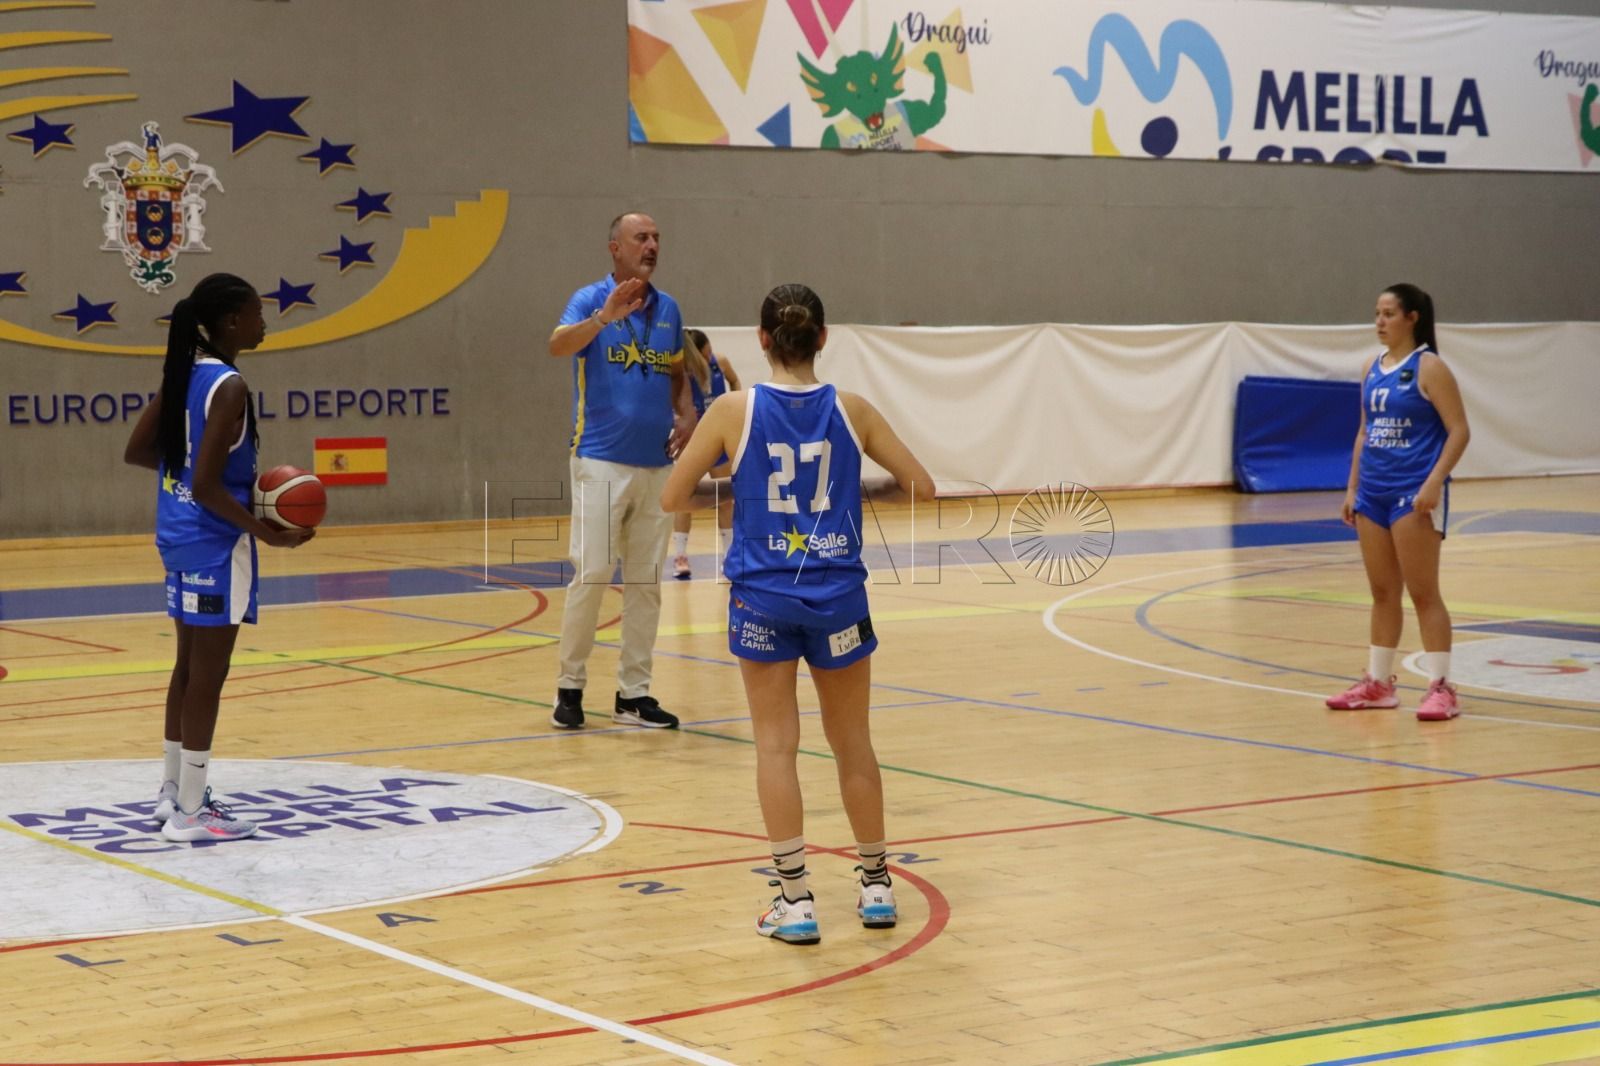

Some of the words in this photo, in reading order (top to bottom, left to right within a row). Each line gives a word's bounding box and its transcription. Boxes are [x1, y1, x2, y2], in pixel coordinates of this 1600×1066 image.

[901, 11, 992, 54] Dragui
[1253, 69, 1490, 137] MELILLA
[608, 346, 625, 362] La
[645, 348, 672, 365] Sall
[8, 393, 157, 425] EUROP
[287, 387, 450, 418] DEPORTE
[1370, 387, 1390, 412] 17
[766, 438, 832, 514] 27
[768, 534, 787, 551] La
[809, 532, 848, 551] Salle
[818, 548, 849, 559] Melilla
[742, 629, 769, 643] SPORT
[743, 620, 777, 637] MELILLA
[740, 638, 776, 652] CAPITAL
